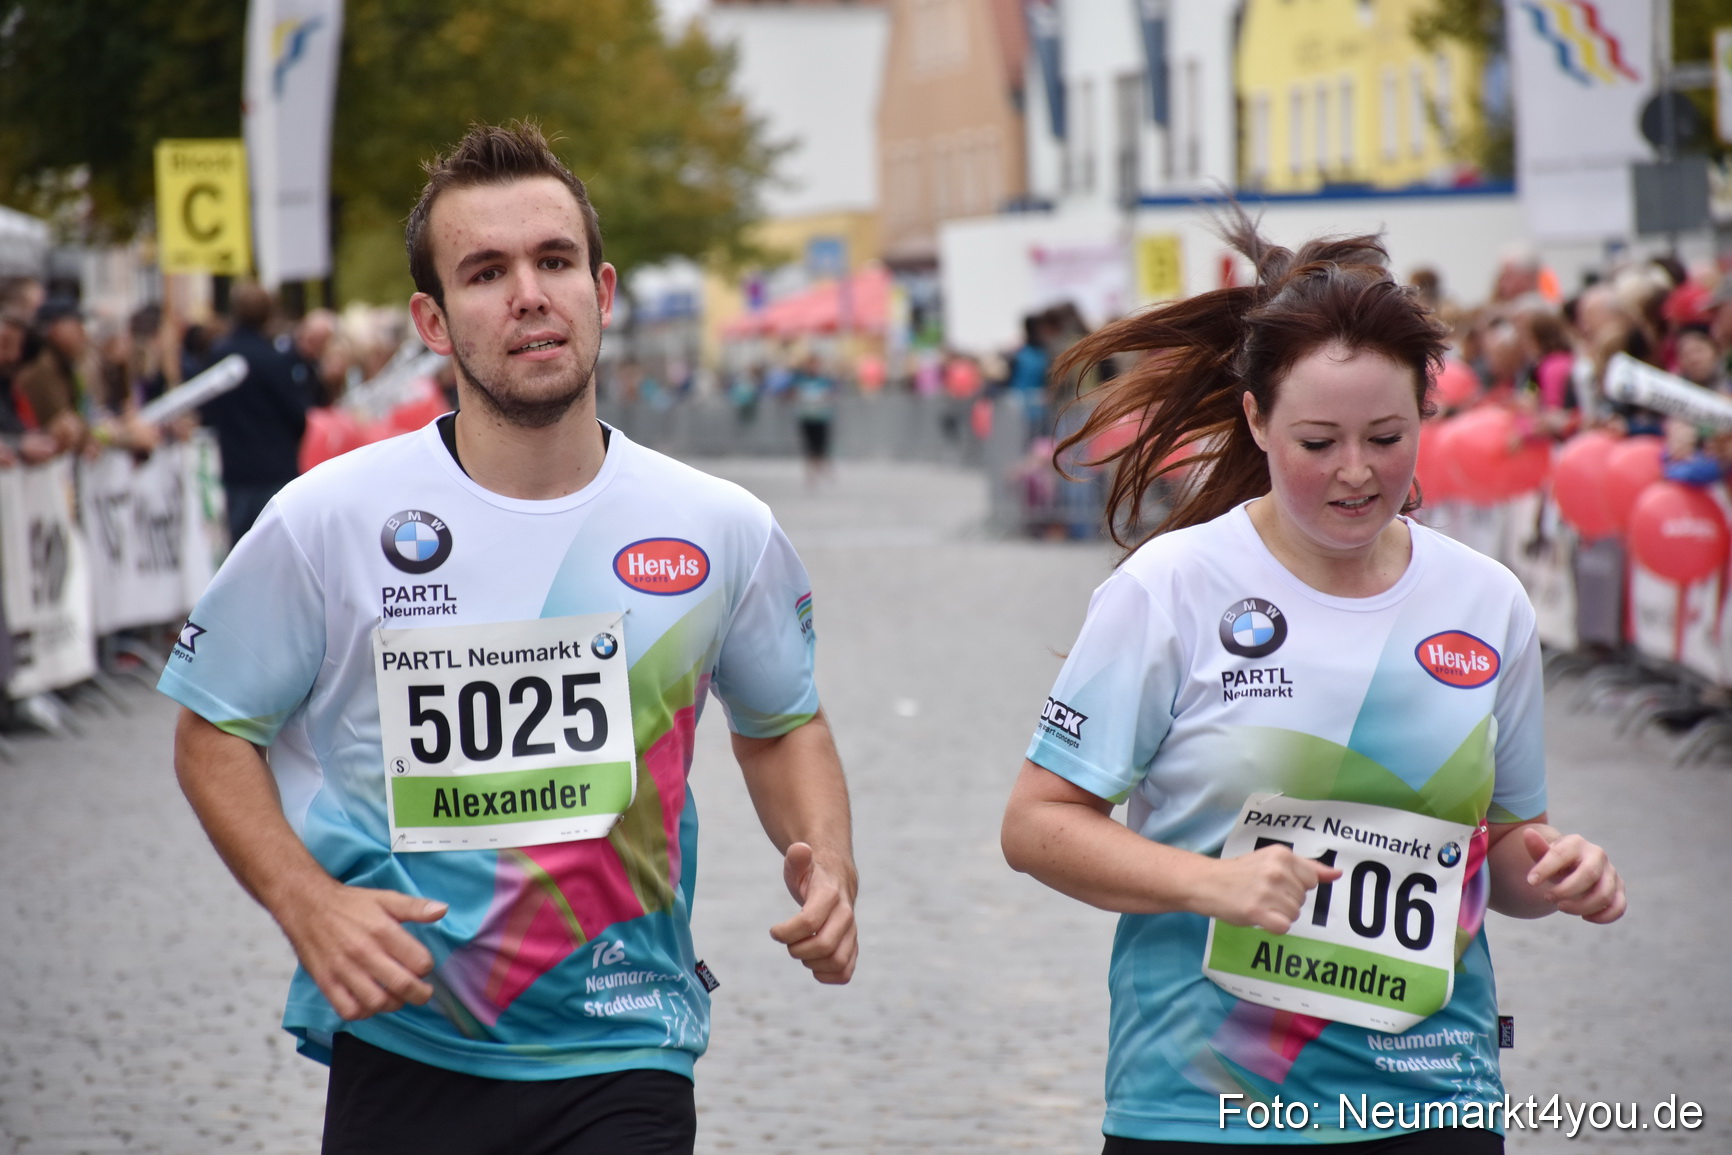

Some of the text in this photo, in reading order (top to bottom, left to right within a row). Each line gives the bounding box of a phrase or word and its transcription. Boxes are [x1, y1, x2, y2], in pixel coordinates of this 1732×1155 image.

[182, 182, 223, 243] C
[386, 511, 446, 532] BMW
[627, 552, 700, 580] Hervis
[381, 584, 457, 604] PARTL
[382, 602, 457, 619] Neumarkt
[1225, 599, 1280, 624] BMW
[382, 641, 582, 671] PARTL Neumarkt
[1428, 643, 1490, 675] Hervis
[1221, 668, 1293, 688] PARTL
[1223, 686, 1293, 702] Neumarkt
[408, 672, 608, 764] 5025
[396, 760, 405, 773] S
[432, 780, 591, 818] Alexander
[1243, 810, 1431, 860] PARTL Neumarkt
[1254, 837, 1438, 951] 106
[1250, 941, 1407, 1002] Alexandra
[584, 989, 664, 1018] Stadtlauf
[1367, 1028, 1475, 1050] Neumarkter
[1375, 1053, 1462, 1073] Stadtlauf
